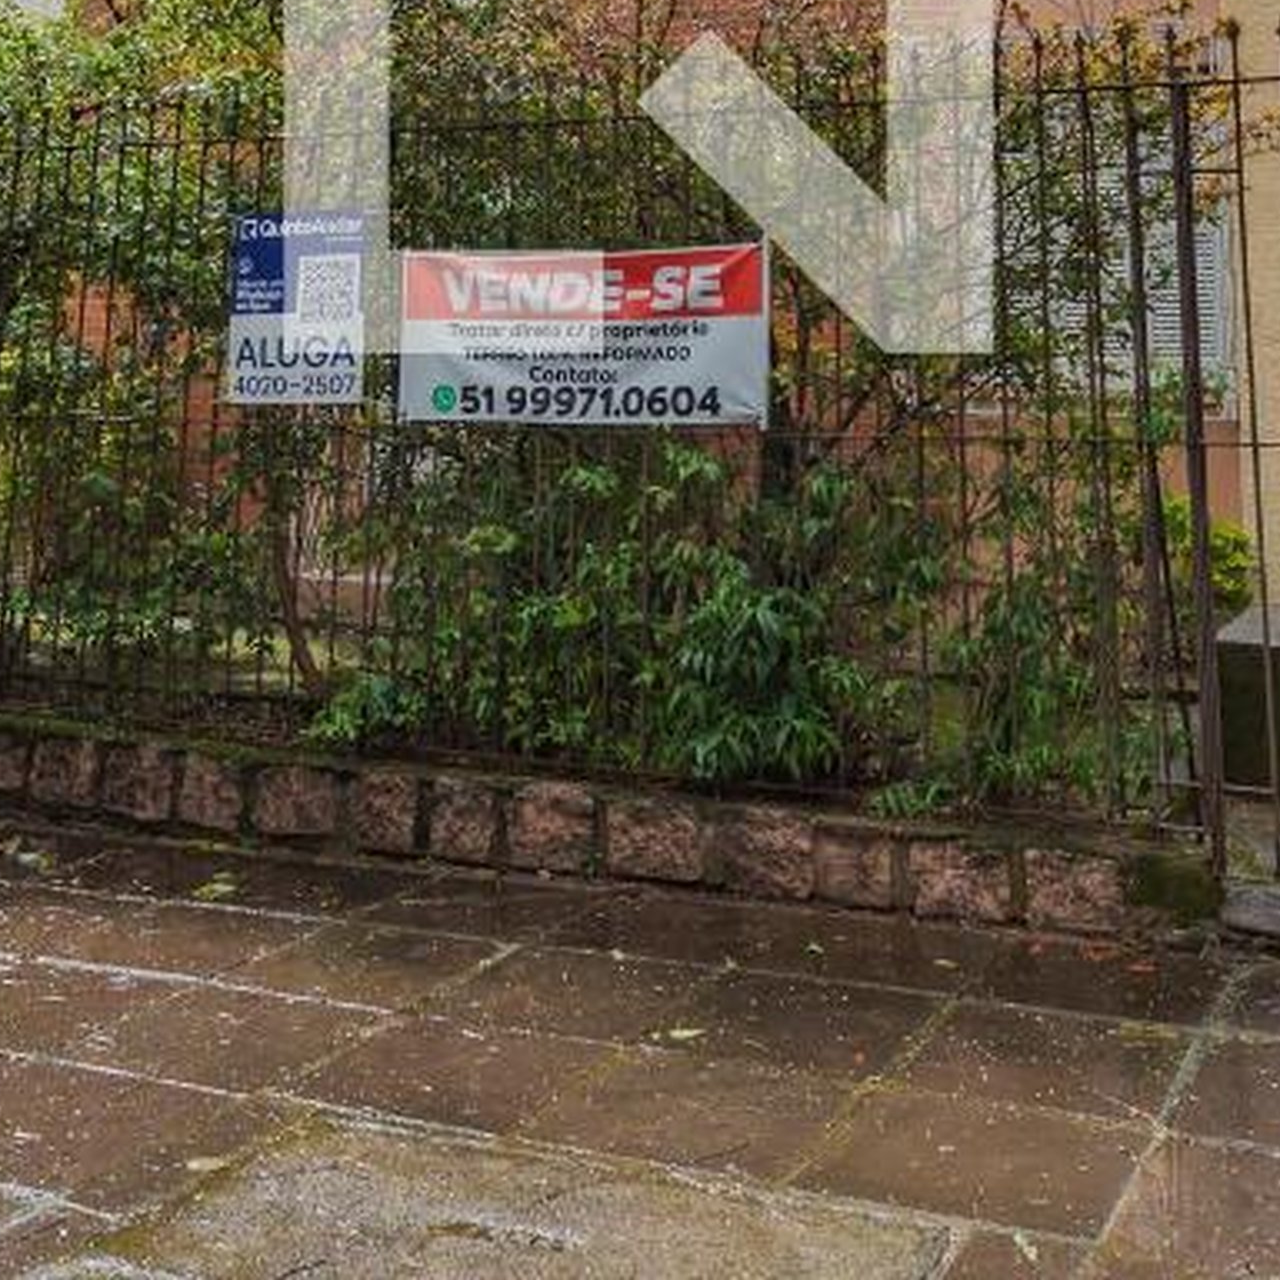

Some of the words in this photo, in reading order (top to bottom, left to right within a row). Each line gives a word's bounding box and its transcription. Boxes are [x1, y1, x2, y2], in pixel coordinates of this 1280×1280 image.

[441, 265, 724, 313] VENDE-SE
[236, 336, 355, 369] ALUGA
[234, 374, 356, 396] 4020-2507
[459, 385, 497, 415] 51
[506, 384, 721, 417] 99971.0604
